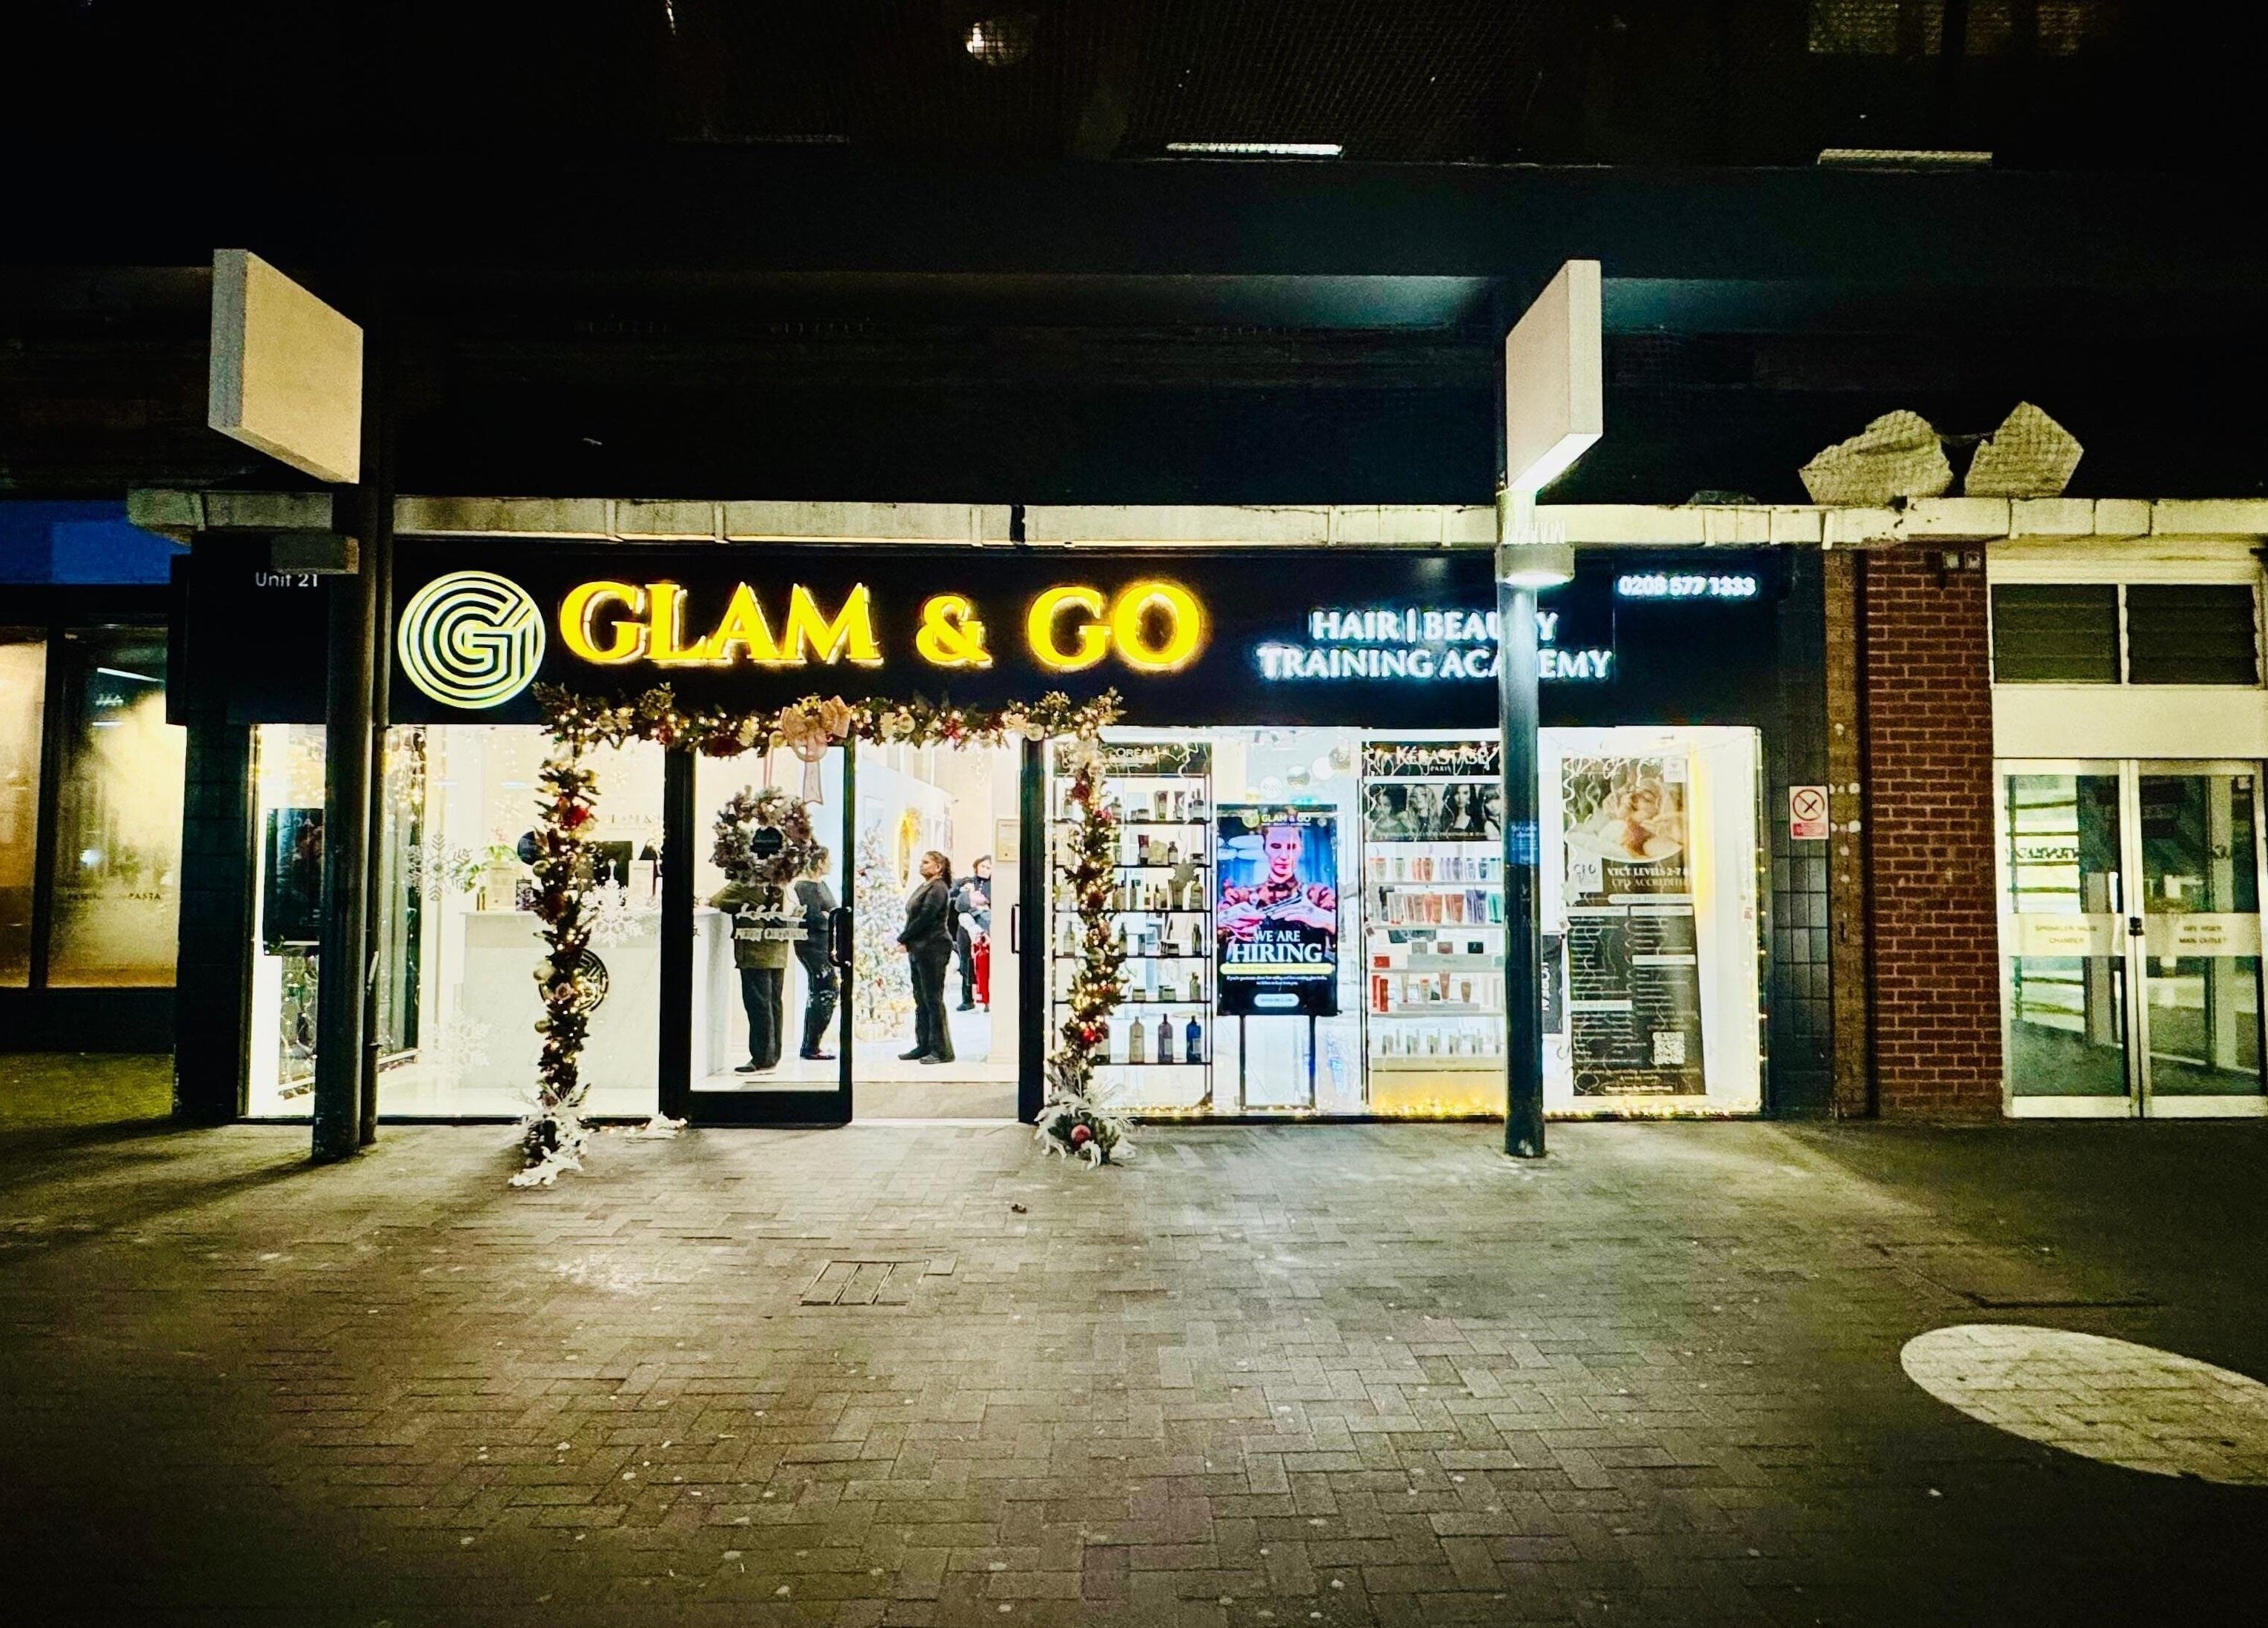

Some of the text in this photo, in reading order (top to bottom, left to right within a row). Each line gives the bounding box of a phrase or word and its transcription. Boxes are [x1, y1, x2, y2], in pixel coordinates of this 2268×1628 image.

[255, 571, 319, 587] Unit 21
[1668, 575, 1707, 596] 577
[560, 580, 1202, 673] GLAM & GO
[1312, 610, 1399, 641] HAIR
[1425, 610, 1559, 641] BEAUY
[1257, 647, 1613, 679] TRAINING ACAEMY
[1261, 814, 1287, 823] GLAM
[1297, 815, 1311, 823] GO
[1254, 930, 1301, 943] WE ARE
[1229, 942, 1322, 963] HIRING
